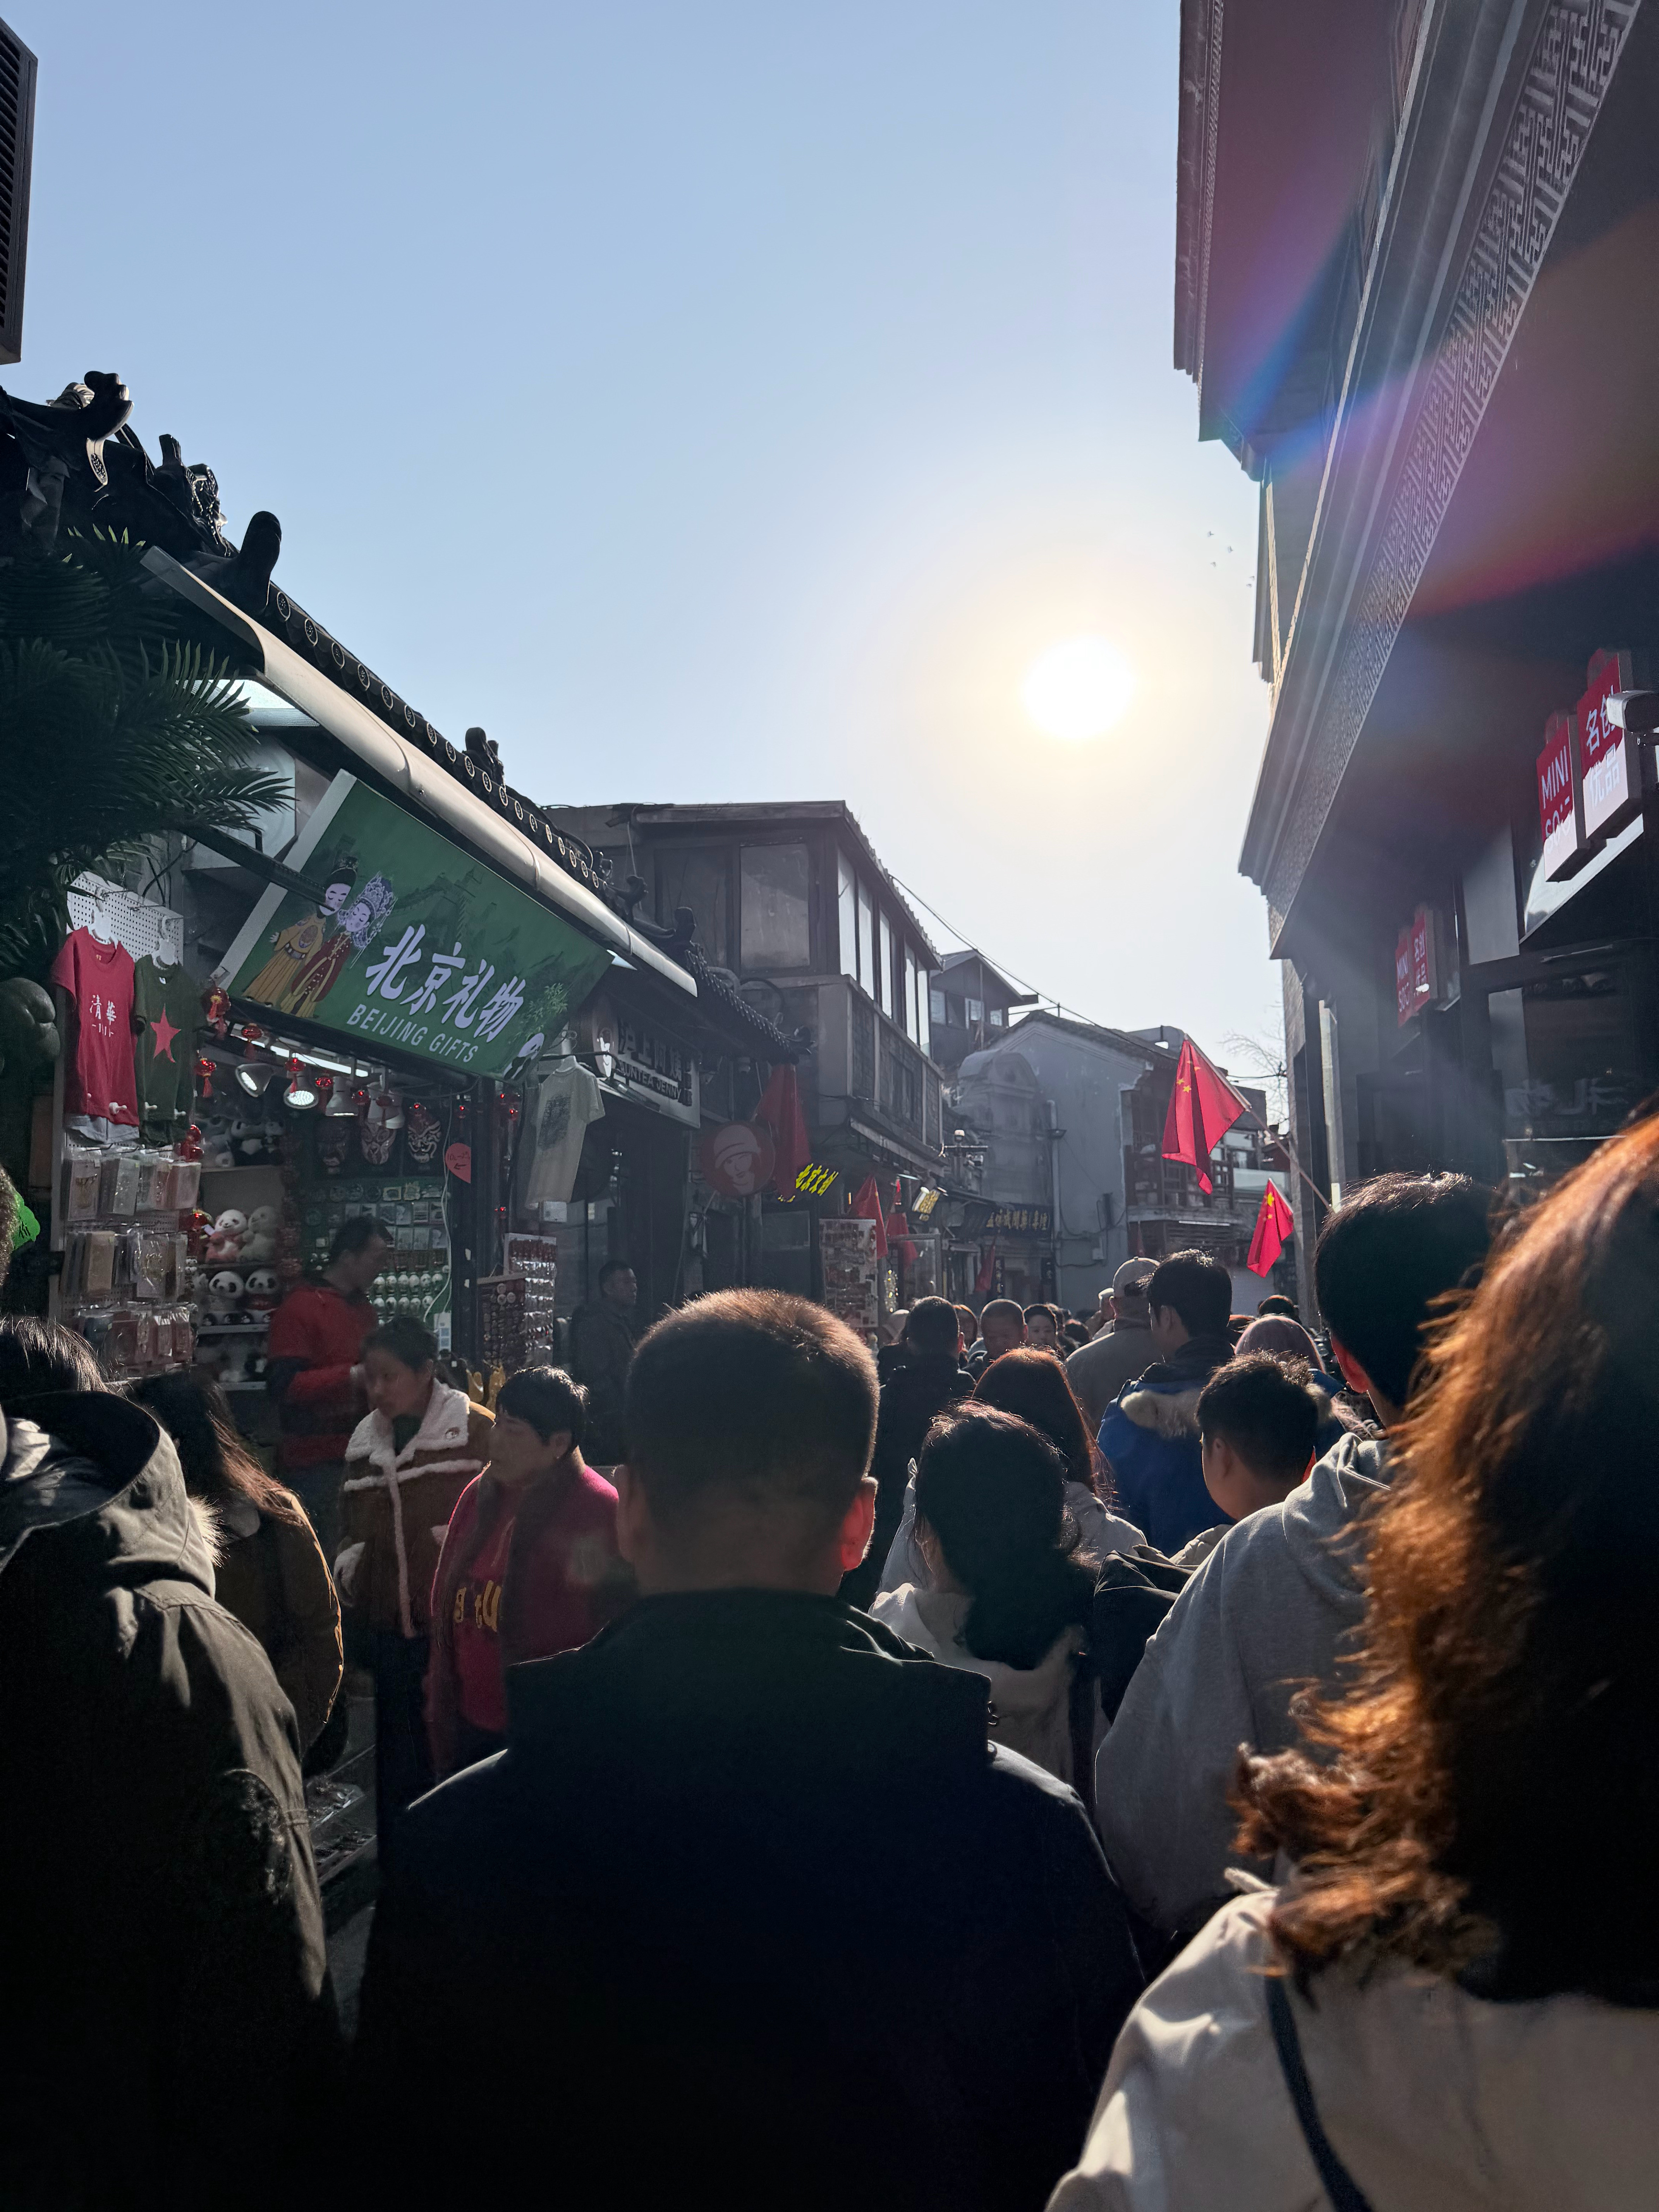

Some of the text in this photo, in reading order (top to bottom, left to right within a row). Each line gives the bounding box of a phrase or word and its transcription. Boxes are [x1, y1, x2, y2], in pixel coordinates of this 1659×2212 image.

[1541, 745, 1569, 810] MINI
[366, 924, 526, 1043] 北京礼物
[1396, 951, 1408, 983] MINI
[347, 1004, 479, 1063] BEIJING GIFTS
[620, 1061, 682, 1099] AUNTEA JENNY
